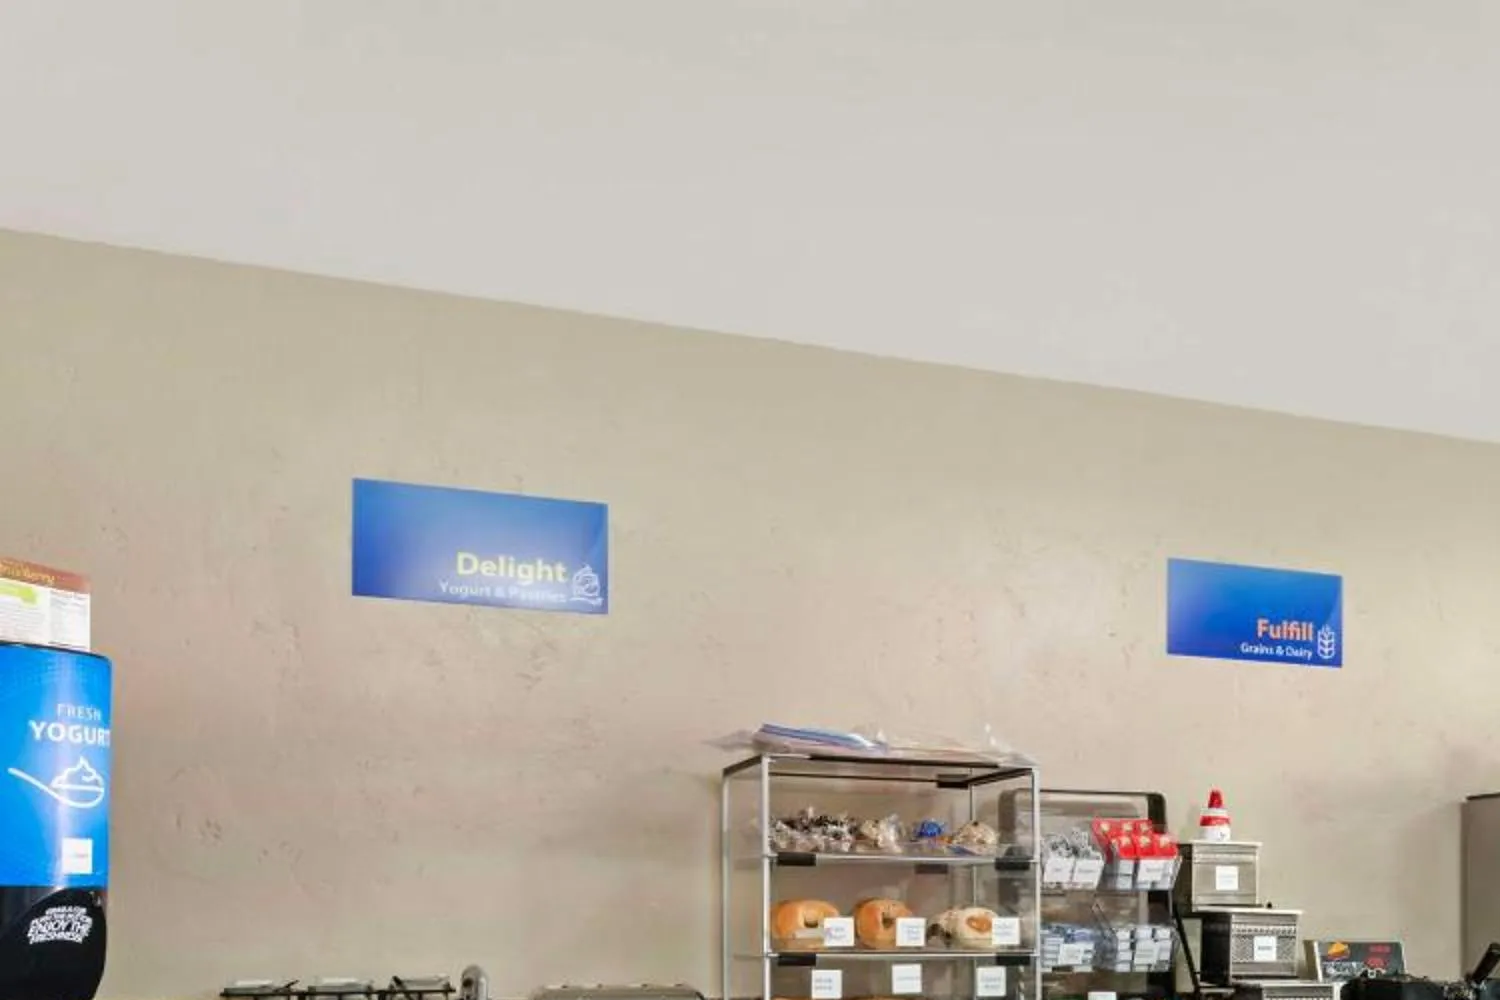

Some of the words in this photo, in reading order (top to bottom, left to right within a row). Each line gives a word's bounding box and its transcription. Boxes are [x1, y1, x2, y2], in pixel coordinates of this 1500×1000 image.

[456, 551, 569, 585] Delight
[438, 578, 491, 600] Yogurt
[1257, 617, 1314, 641] Fulfill
[1240, 642, 1274, 654] Grains
[1275, 645, 1285, 656] &
[1285, 646, 1313, 660] Dairy
[57, 703, 103, 721] FRESH
